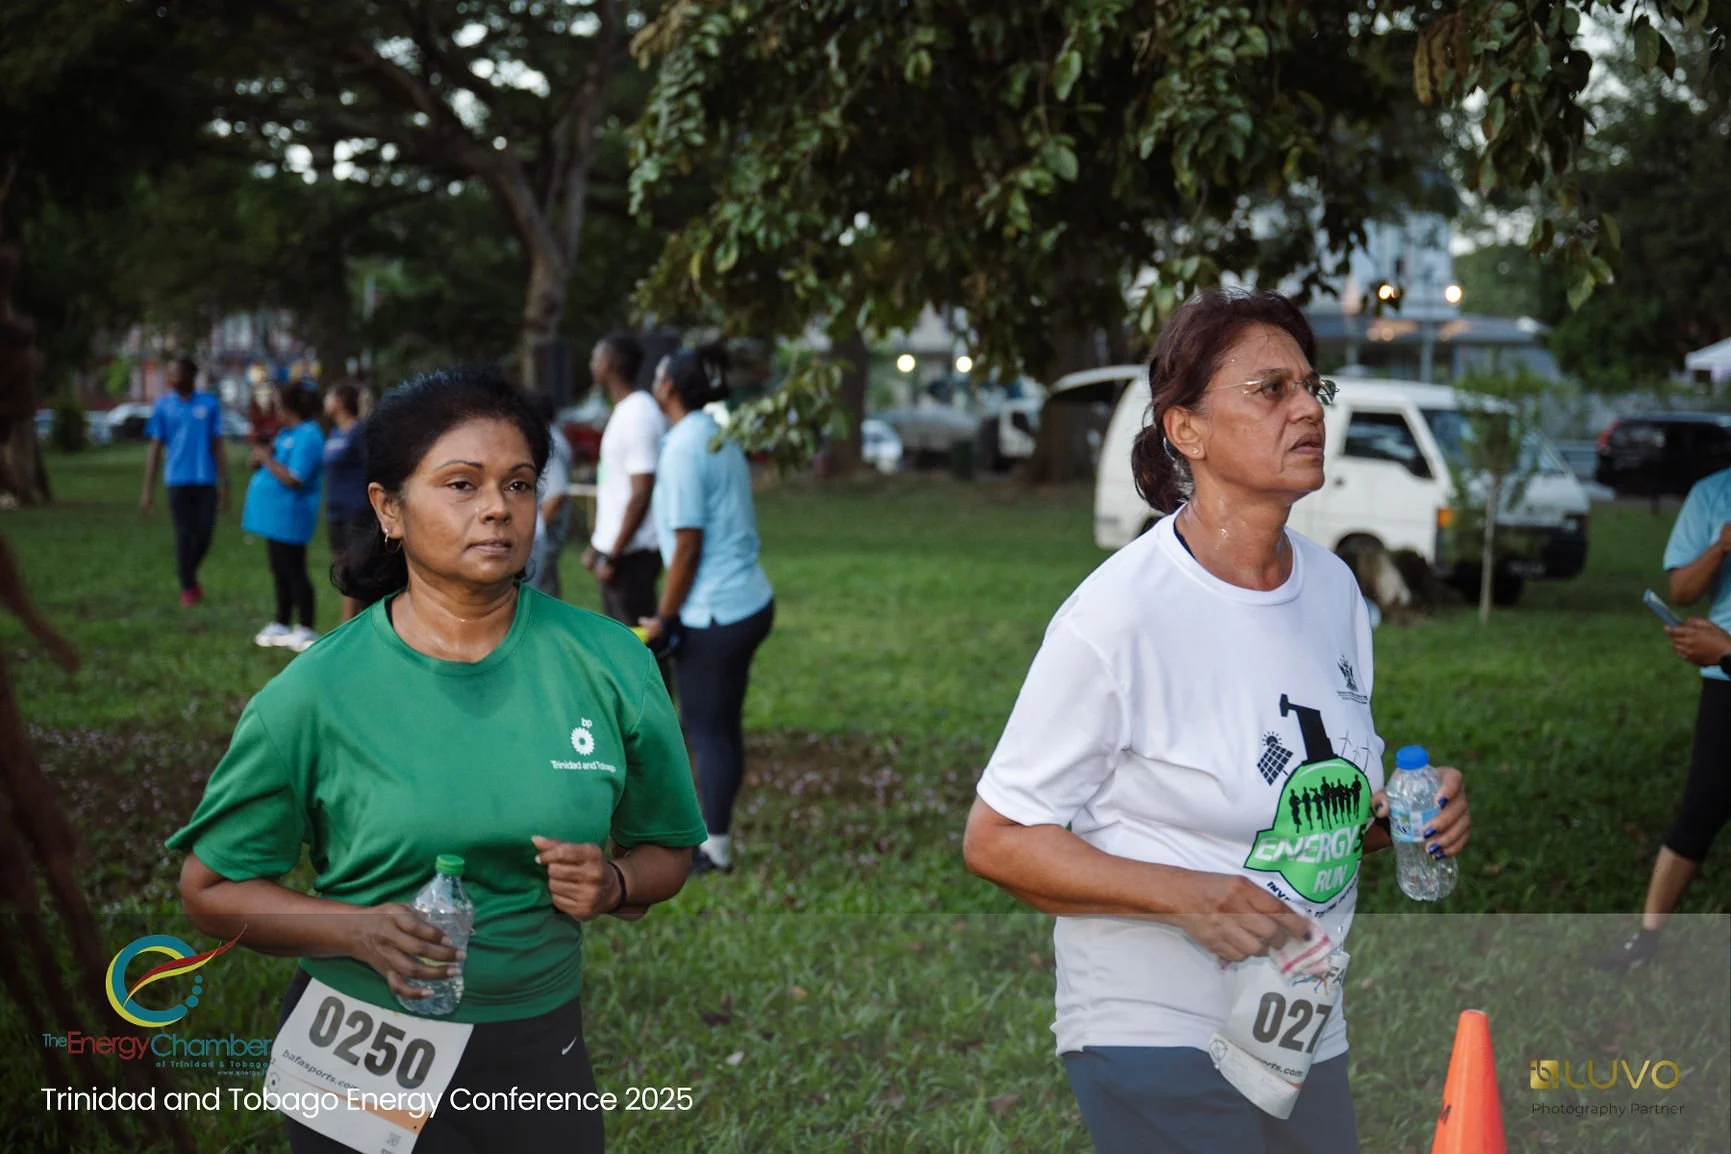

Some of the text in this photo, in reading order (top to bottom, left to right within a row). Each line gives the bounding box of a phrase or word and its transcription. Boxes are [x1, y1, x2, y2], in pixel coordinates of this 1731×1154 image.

[581, 717, 593, 728] bp
[550, 760, 581, 770] Trinidad
[582, 761, 597, 770] and
[1254, 824, 1360, 864] ENERGY
[1312, 864, 1349, 894] RUN
[309, 996, 436, 1089] 0250
